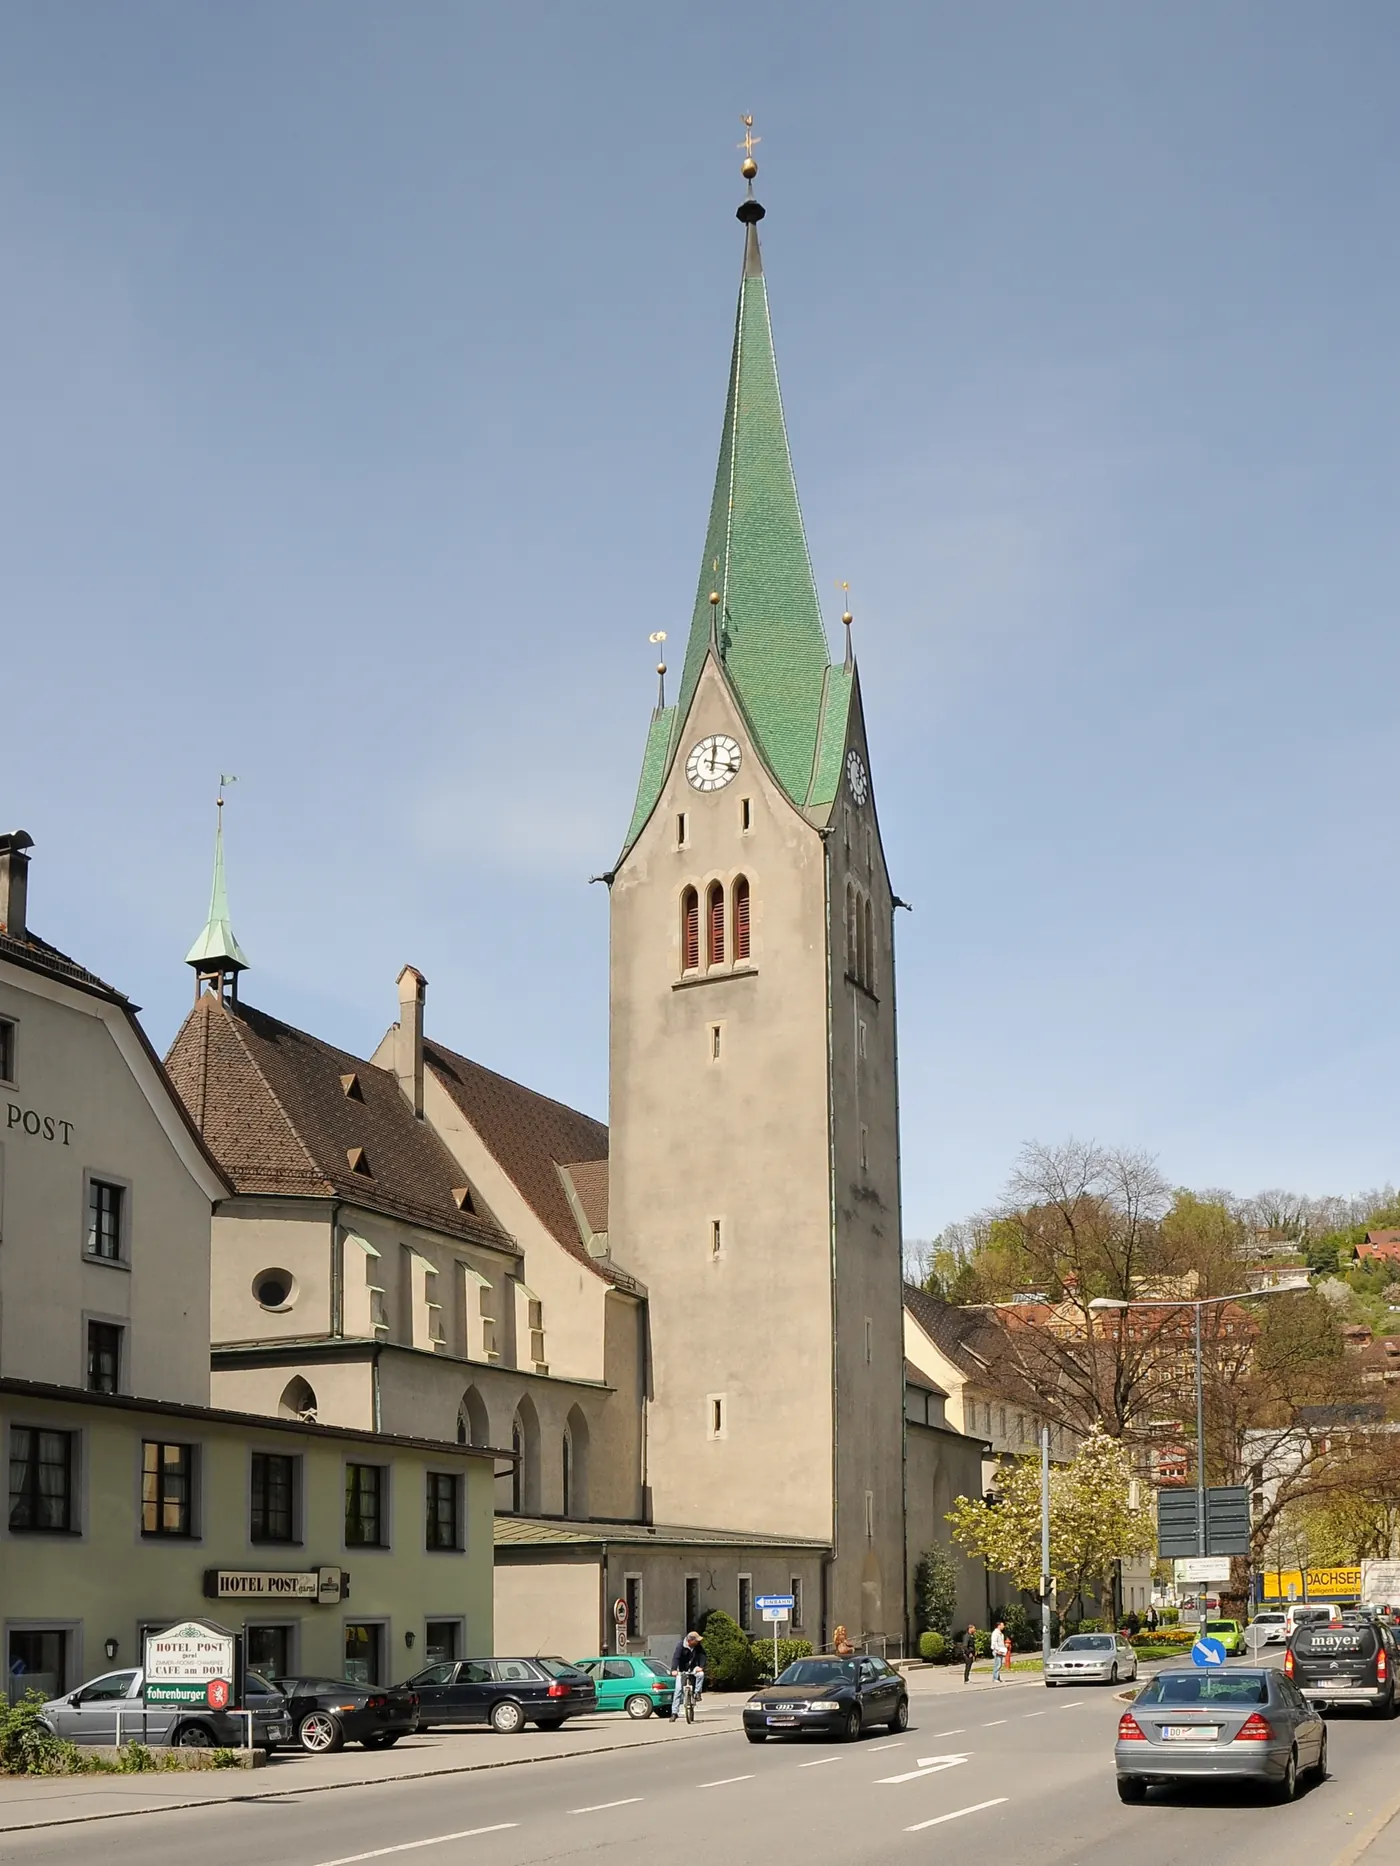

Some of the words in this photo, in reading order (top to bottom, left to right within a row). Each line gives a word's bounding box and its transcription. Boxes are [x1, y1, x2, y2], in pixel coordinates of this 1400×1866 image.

[7, 1102, 75, 1146] POST
[220, 1576, 264, 1592] HOTEL
[267, 1577, 299, 1592] POST
[1306, 1572, 1361, 1586] DACHSER
[156, 1643, 192, 1652] HOTEL
[197, 1643, 224, 1652] POST
[1310, 1636, 1360, 1651] mayer
[155, 1666, 181, 1675] CAFE
[184, 1667, 198, 1675] am
[202, 1666, 223, 1675] DOM
[146, 1686, 206, 1702] fohrenburger
